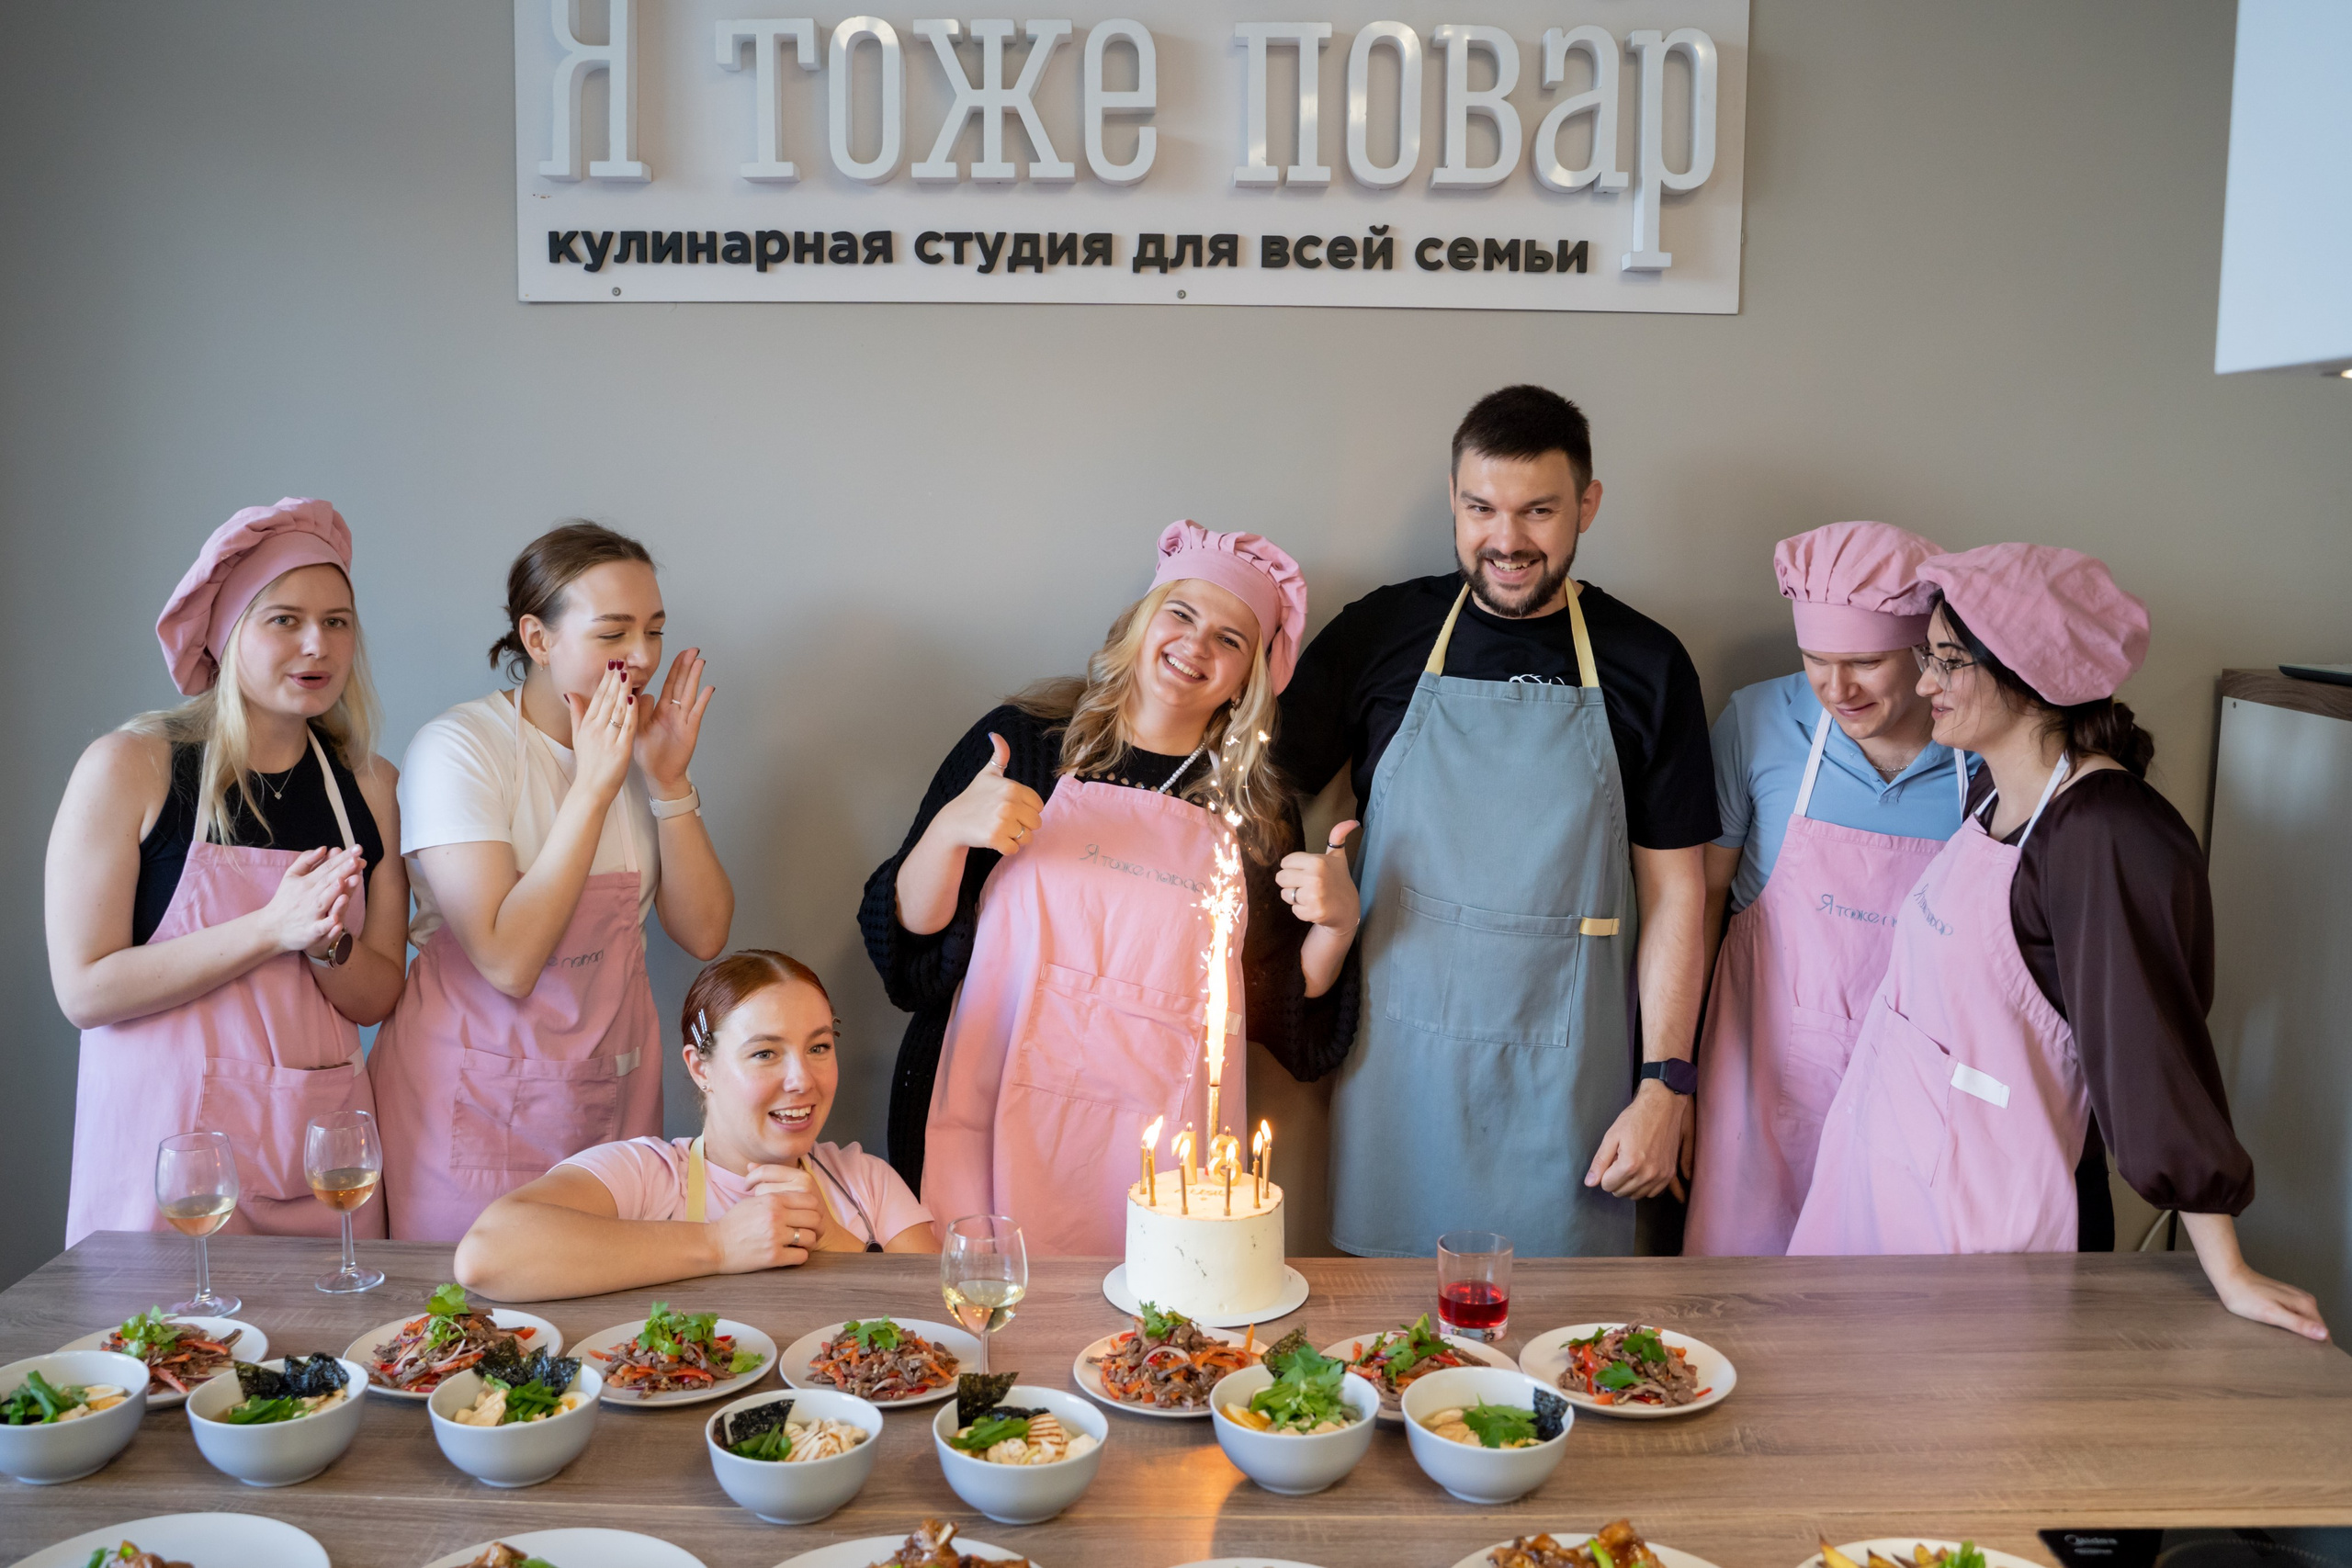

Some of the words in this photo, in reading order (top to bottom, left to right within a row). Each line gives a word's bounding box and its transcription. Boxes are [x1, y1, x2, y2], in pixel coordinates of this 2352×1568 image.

[538, 0, 651, 183] Я
[715, 16, 1157, 185] тоже
[1233, 20, 1718, 272] повар
[548, 229, 894, 273] кулинарная
[914, 231, 1113, 274] студия
[1132, 232, 1238, 274] для
[1261, 224, 1393, 271] всей
[1414, 236, 1589, 274] семьи
[1079, 843, 1100, 864] Я
[1815, 894, 1834, 915] Я
